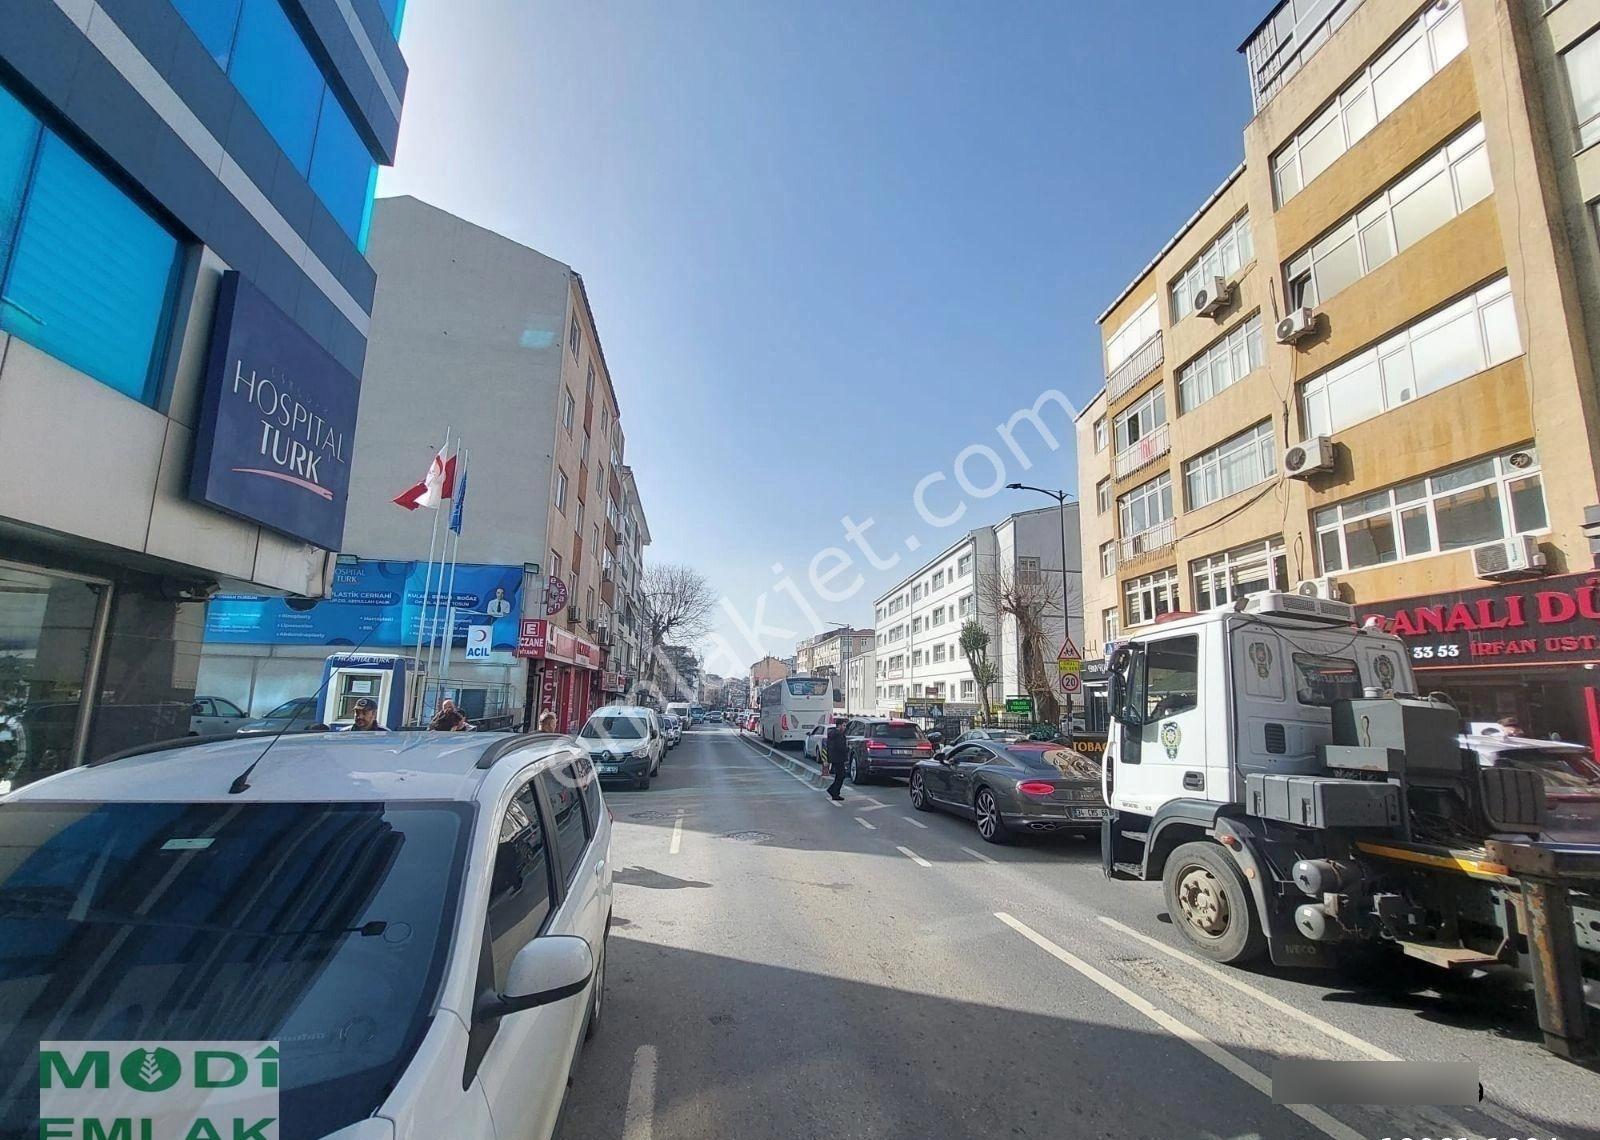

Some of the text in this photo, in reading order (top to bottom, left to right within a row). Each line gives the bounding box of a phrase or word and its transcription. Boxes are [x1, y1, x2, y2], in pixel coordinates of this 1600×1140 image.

[234, 360, 345, 463] HOSPITAL
[261, 420, 321, 483] TURK
[334, 568, 366, 576] OSPITAL
[526, 624, 537, 635] E
[519, 637, 544, 648] CZANE
[1413, 634, 1600, 659] 33 53 İRFAN UST
[467, 646, 490, 657] ACİL
[1065, 677, 1076, 687] 20
